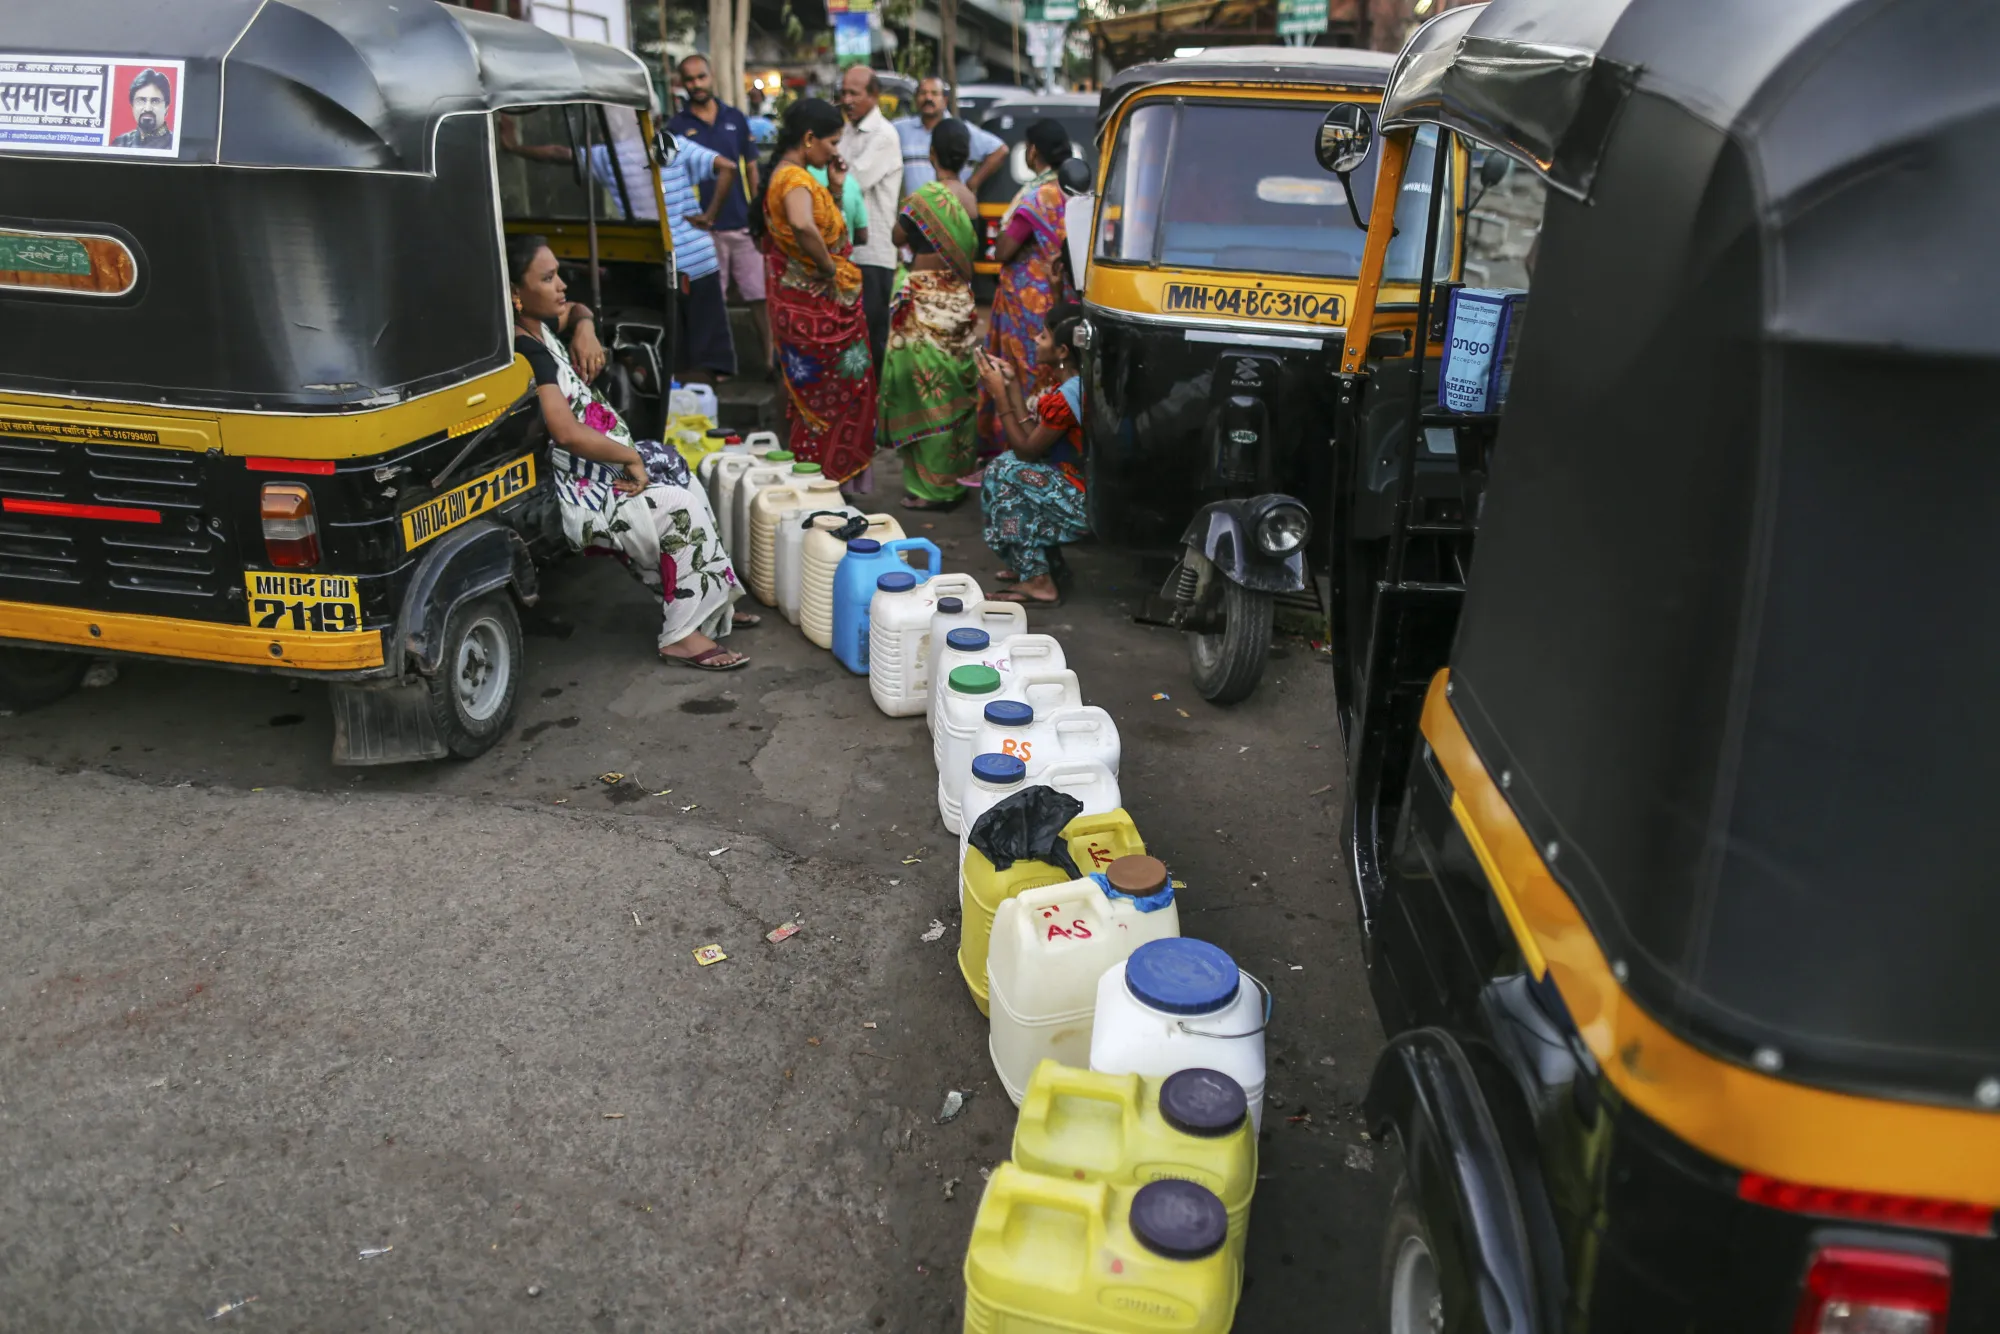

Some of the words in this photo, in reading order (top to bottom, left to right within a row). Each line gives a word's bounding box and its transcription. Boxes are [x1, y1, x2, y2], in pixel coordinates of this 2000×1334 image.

[0, 82, 99, 115] समाचार
[1453, 337, 1490, 356] ongo
[1447, 381, 1484, 395] BHADA
[1460, 378, 1477, 387] AUTO
[1448, 391, 1479, 402] MOBILE
[1460, 400, 1473, 409] DO
[467, 461, 530, 514] 7119
[254, 598, 357, 633] 7119
